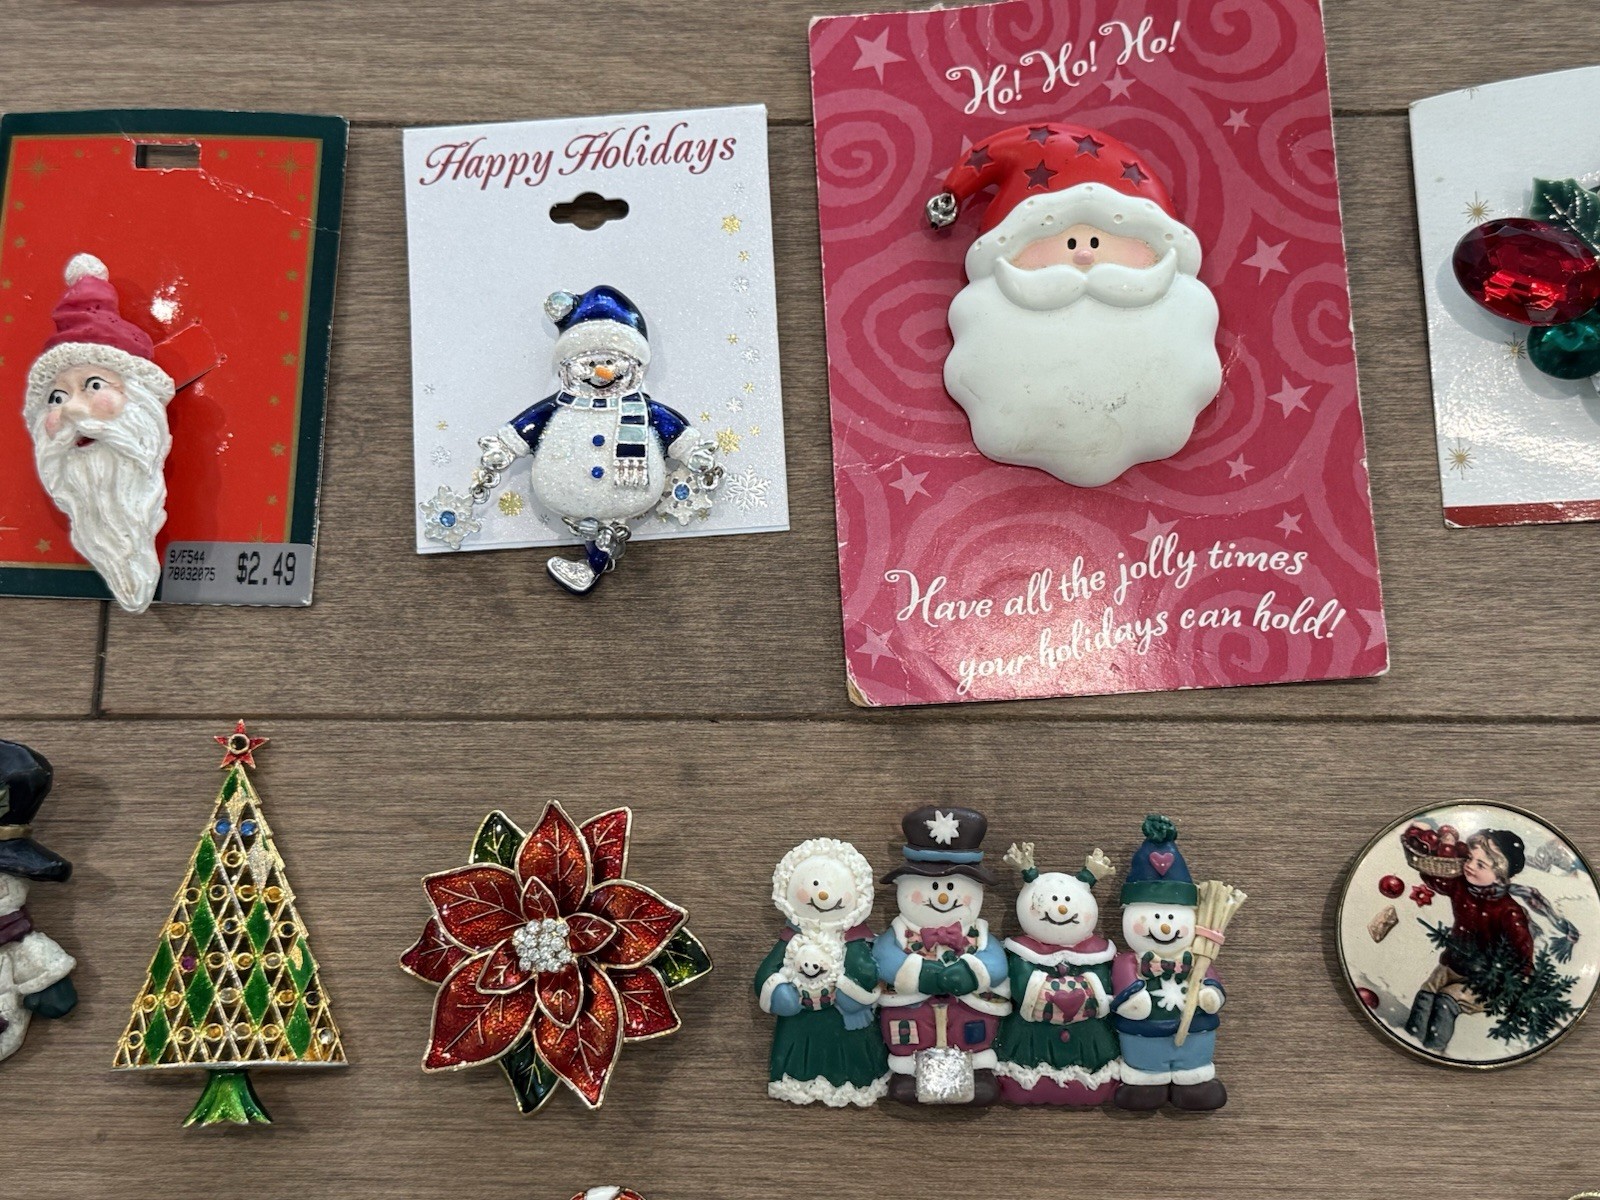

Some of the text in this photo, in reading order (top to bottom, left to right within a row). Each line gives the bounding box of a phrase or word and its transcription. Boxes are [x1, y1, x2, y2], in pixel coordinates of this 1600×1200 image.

[945, 16, 1181, 115] Ho! Ho! Ho!
[419, 122, 737, 190] Happy Holidays
[236, 551, 297, 586] $2.49
[884, 532, 1309, 627] Have all the jolly times
[956, 590, 1347, 695] your holidays can hold!
